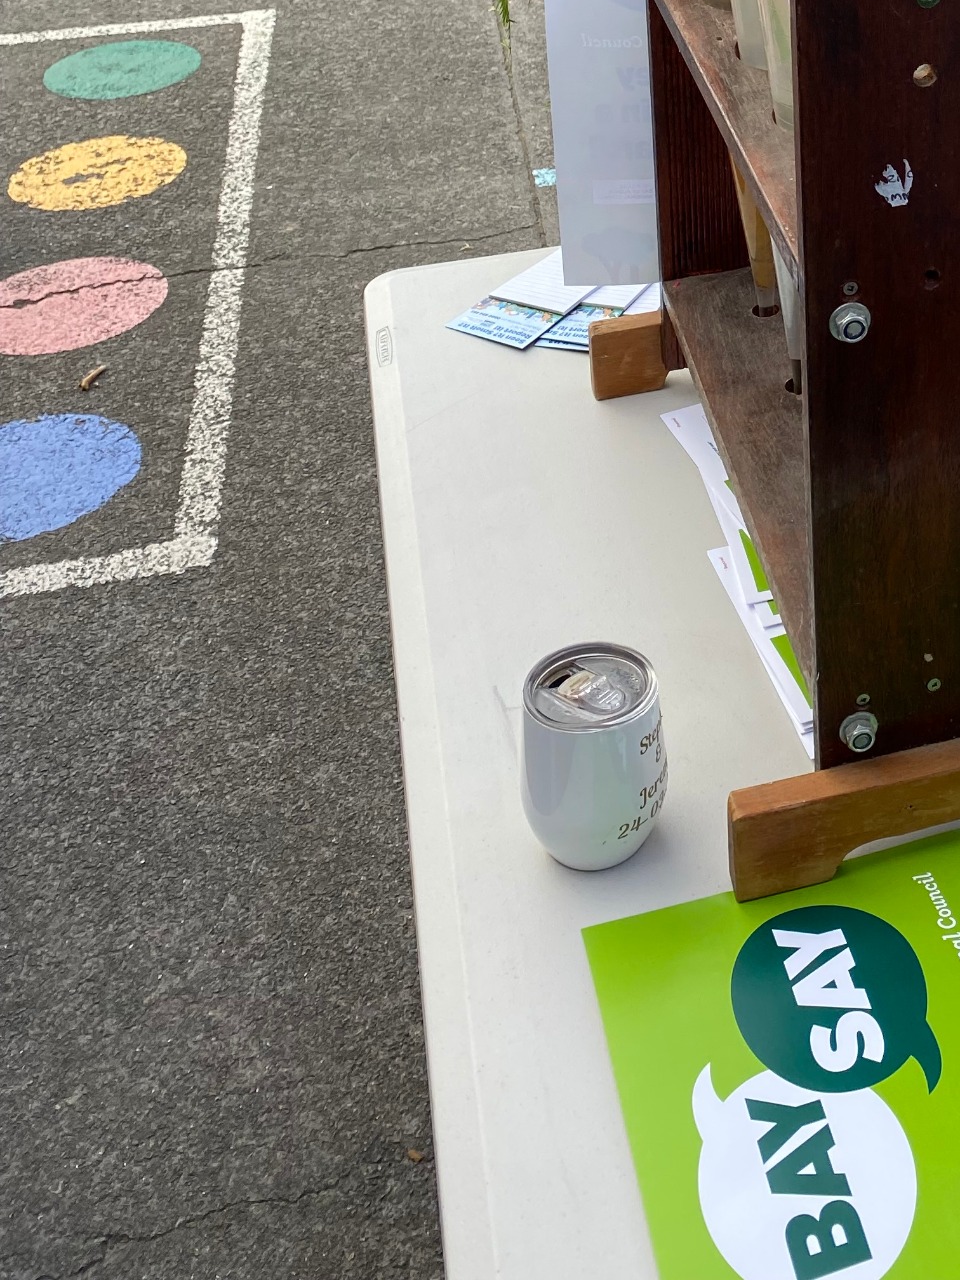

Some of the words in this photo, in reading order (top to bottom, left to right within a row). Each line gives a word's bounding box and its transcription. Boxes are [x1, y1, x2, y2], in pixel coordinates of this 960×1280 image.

[911, 871, 957, 930] Council
[771, 928, 885, 1073] SAY
[745, 1098, 873, 1280] BAY
